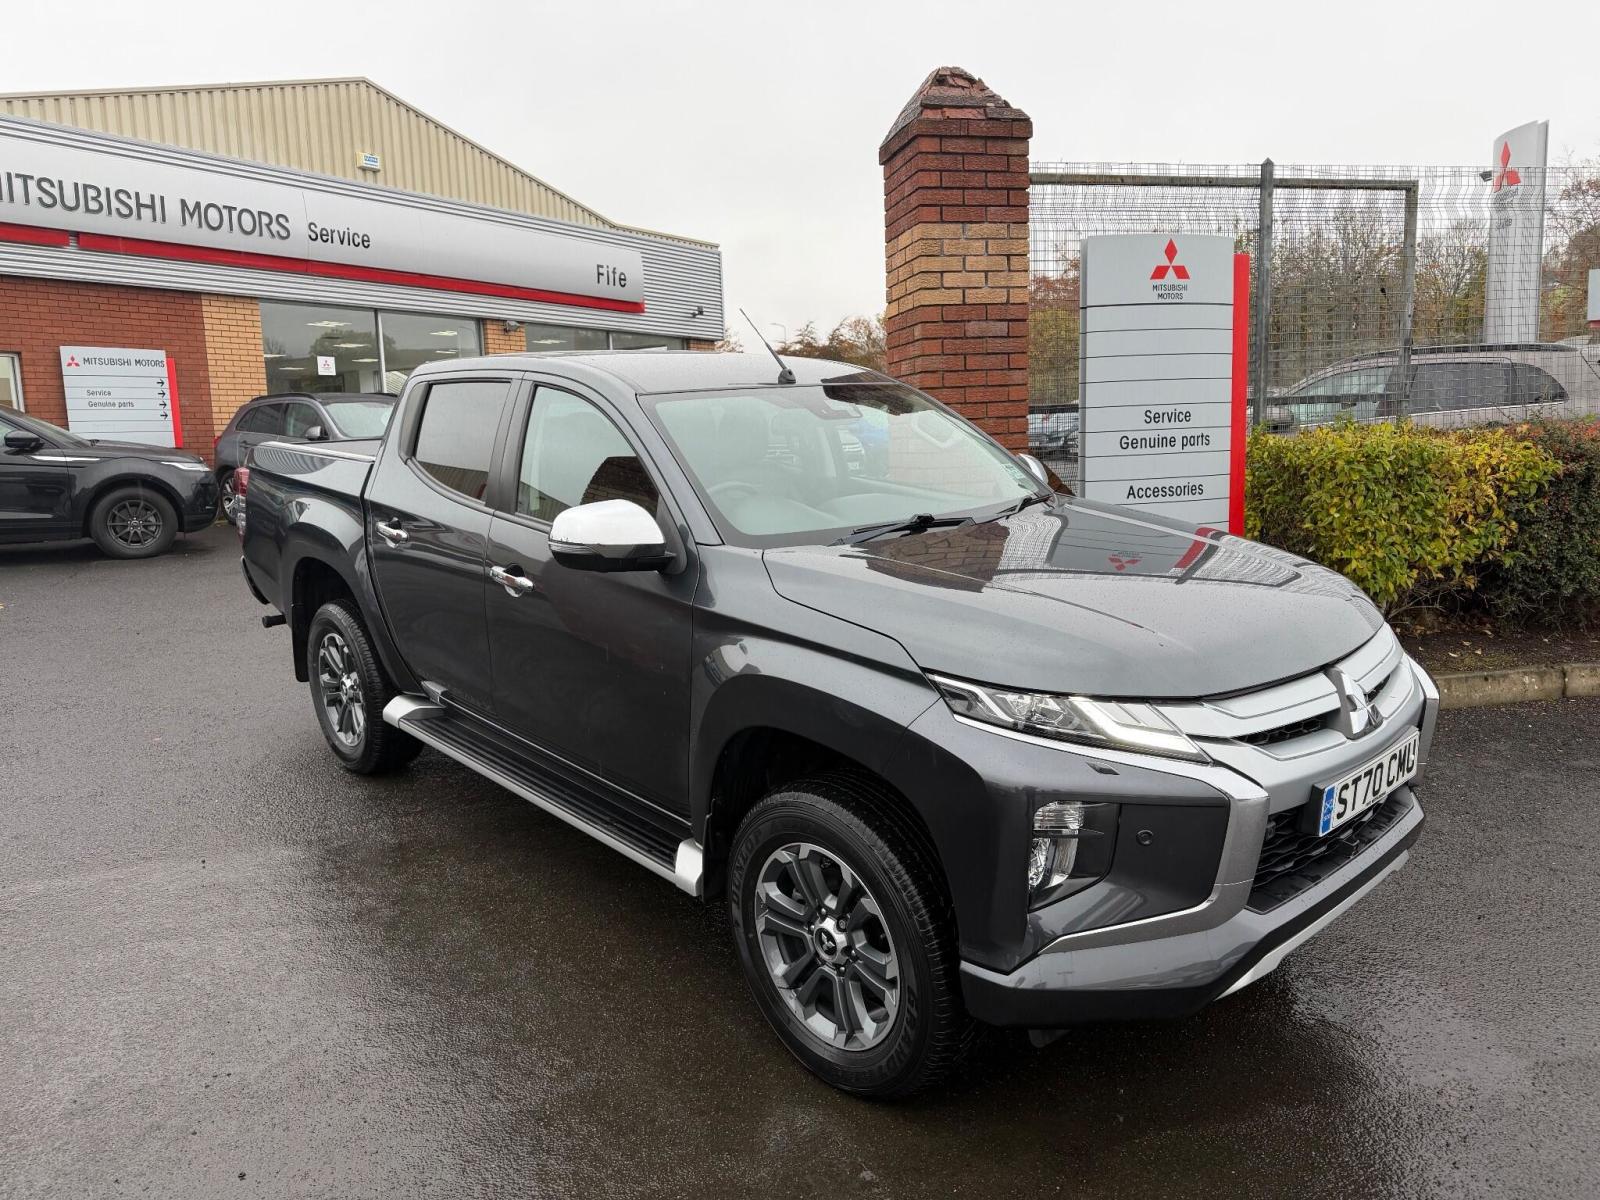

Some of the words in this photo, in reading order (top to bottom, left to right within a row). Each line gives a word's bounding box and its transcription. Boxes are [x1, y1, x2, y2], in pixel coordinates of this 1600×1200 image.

[0, 171, 166, 223] ITSUBISHI
[180, 198, 291, 240] MOTORS
[308, 222, 371, 249] Service
[596, 263, 627, 288] Fife
[1152, 284, 1188, 292] MITSUBISHI
[83, 357, 132, 366] MITSUBISHI
[134, 358, 165, 368] MOTORS
[86, 389, 112, 397] Service
[88, 400, 117, 408] Genuine
[118, 401, 135, 409] parts
[1144, 408, 1192, 424] Service
[1119, 434, 1177, 450] Genuine
[1181, 432, 1211, 450] parts
[1126, 482, 1204, 499] Accessories
[1336, 762, 1384, 819] ST70
[1386, 738, 1417, 787] CMU
